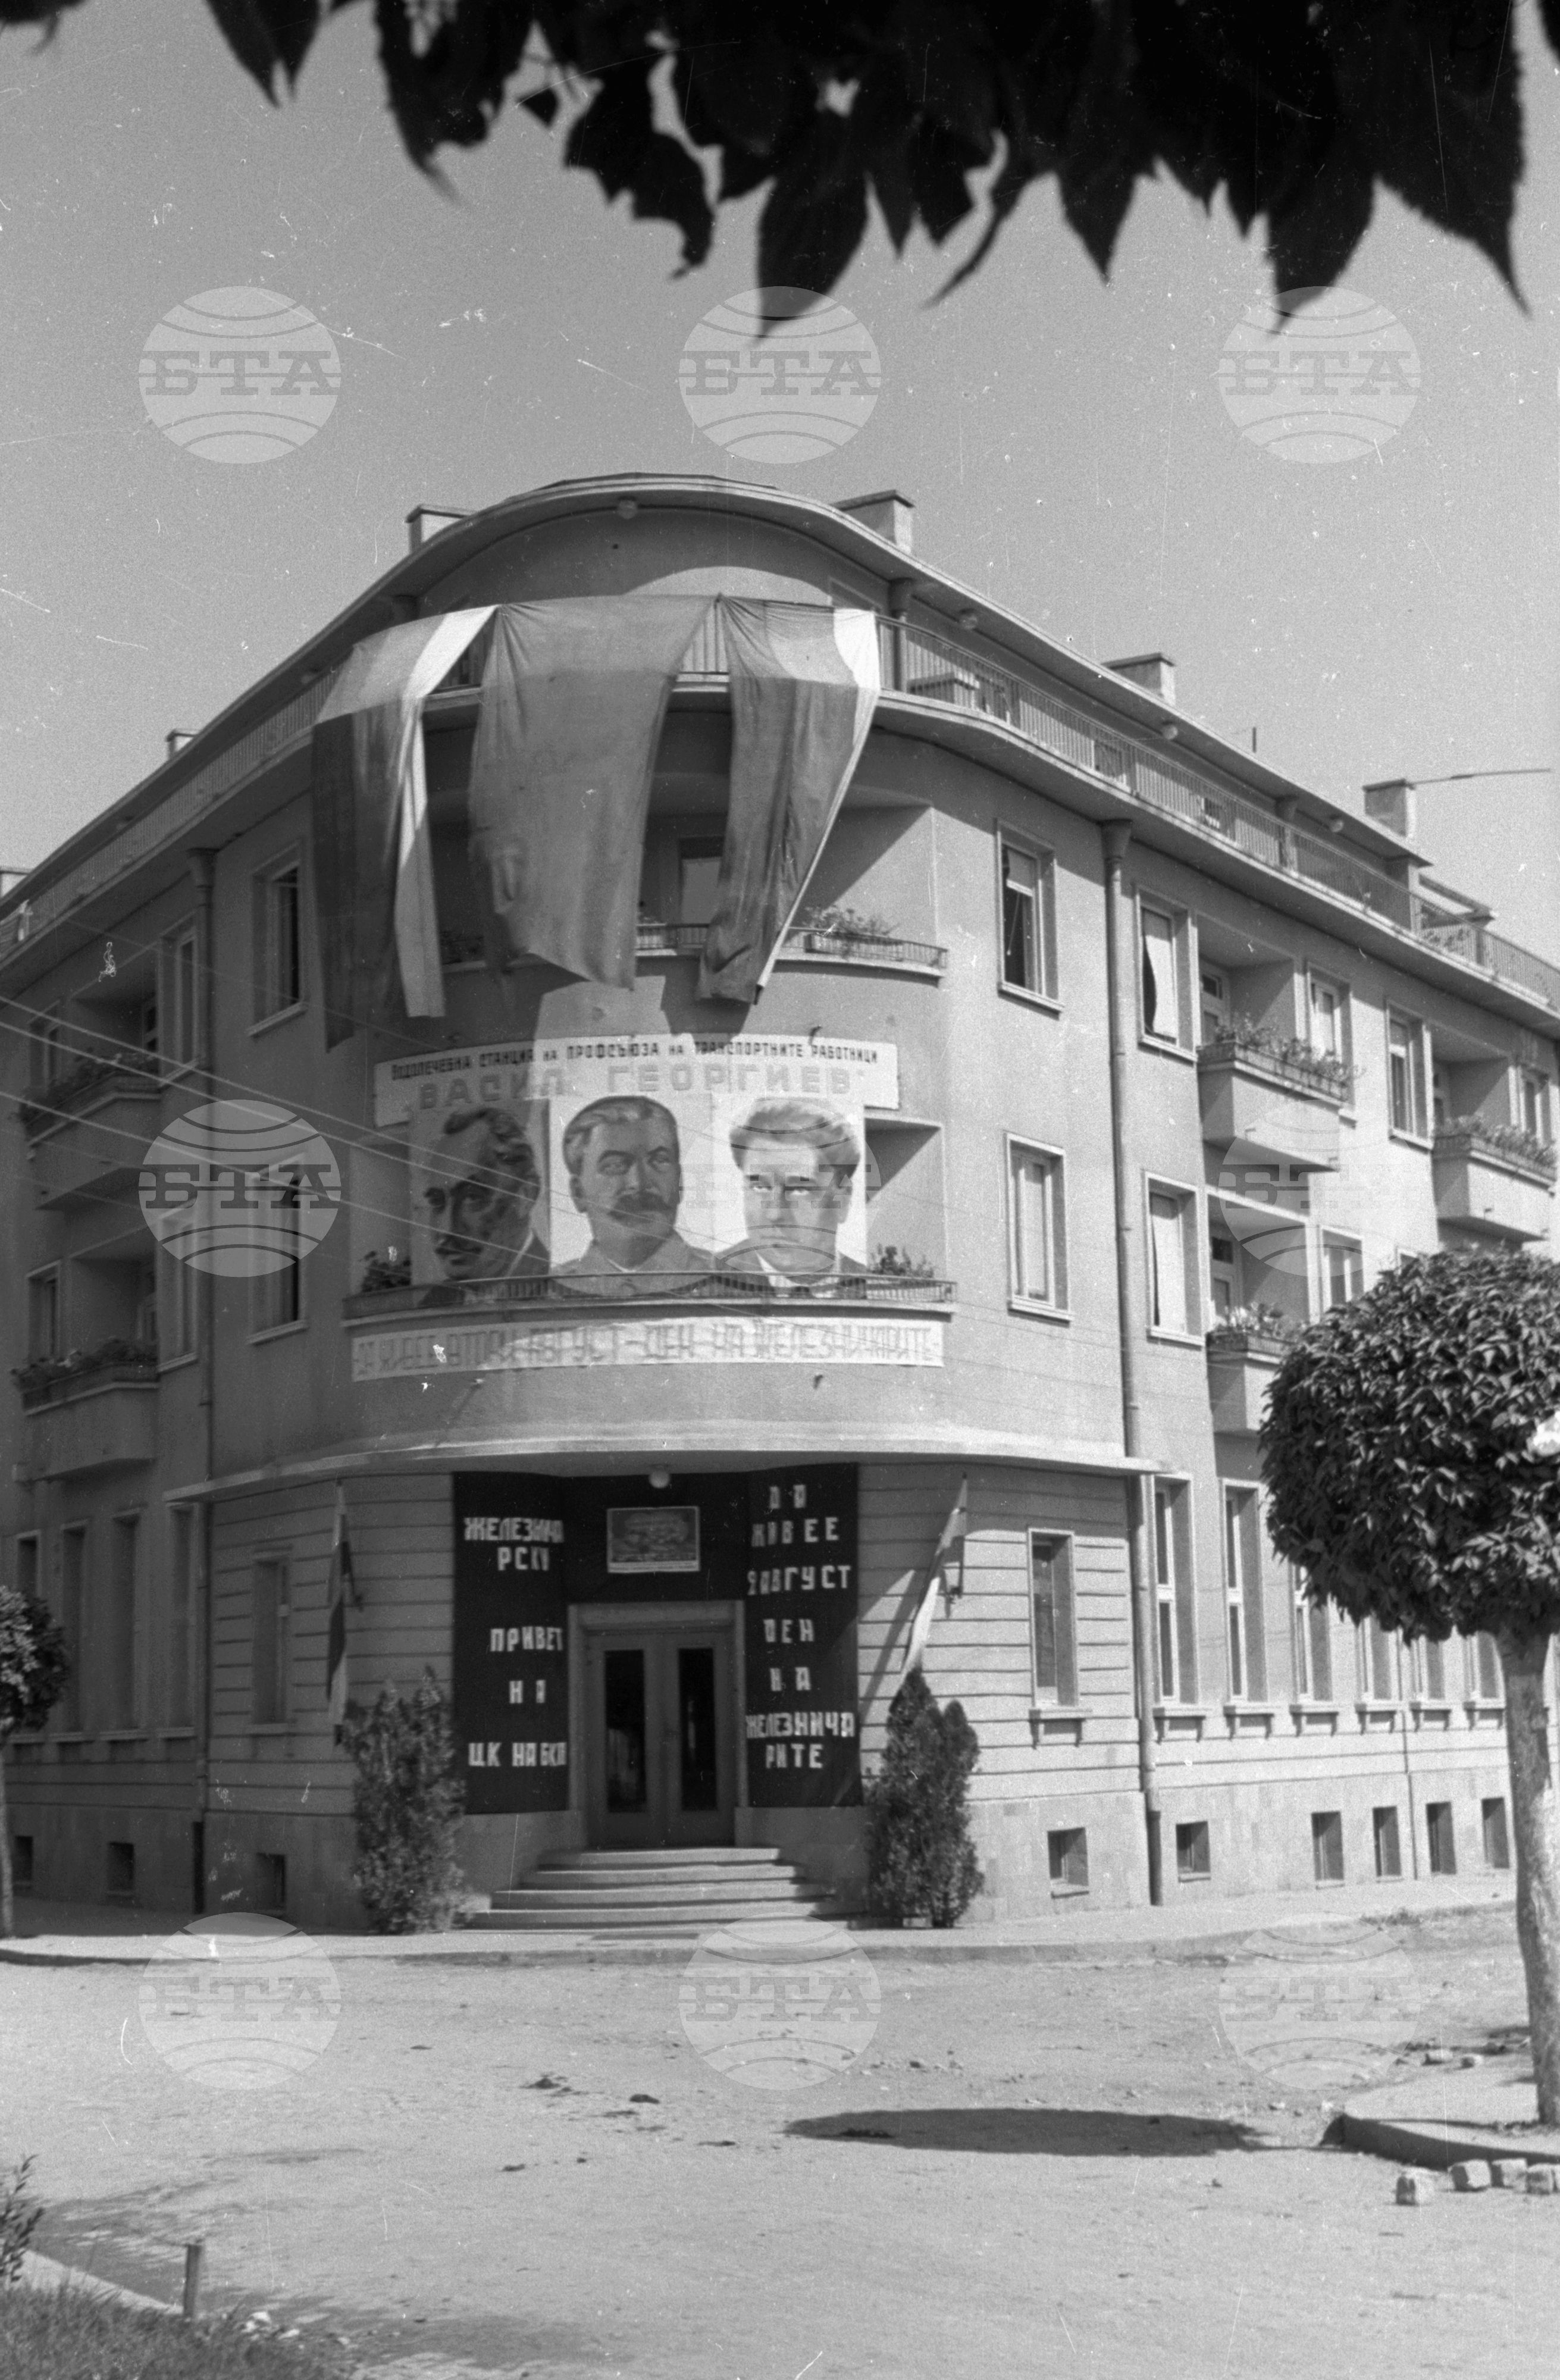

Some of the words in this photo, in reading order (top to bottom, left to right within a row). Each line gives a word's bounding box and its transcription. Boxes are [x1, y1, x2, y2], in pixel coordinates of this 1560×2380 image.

[811, 1044, 878, 1064] РАБОТНИЦИ
[490, 1626, 564, 1652] ПРИВЕТ
[468, 1742, 502, 1767] ЦК
